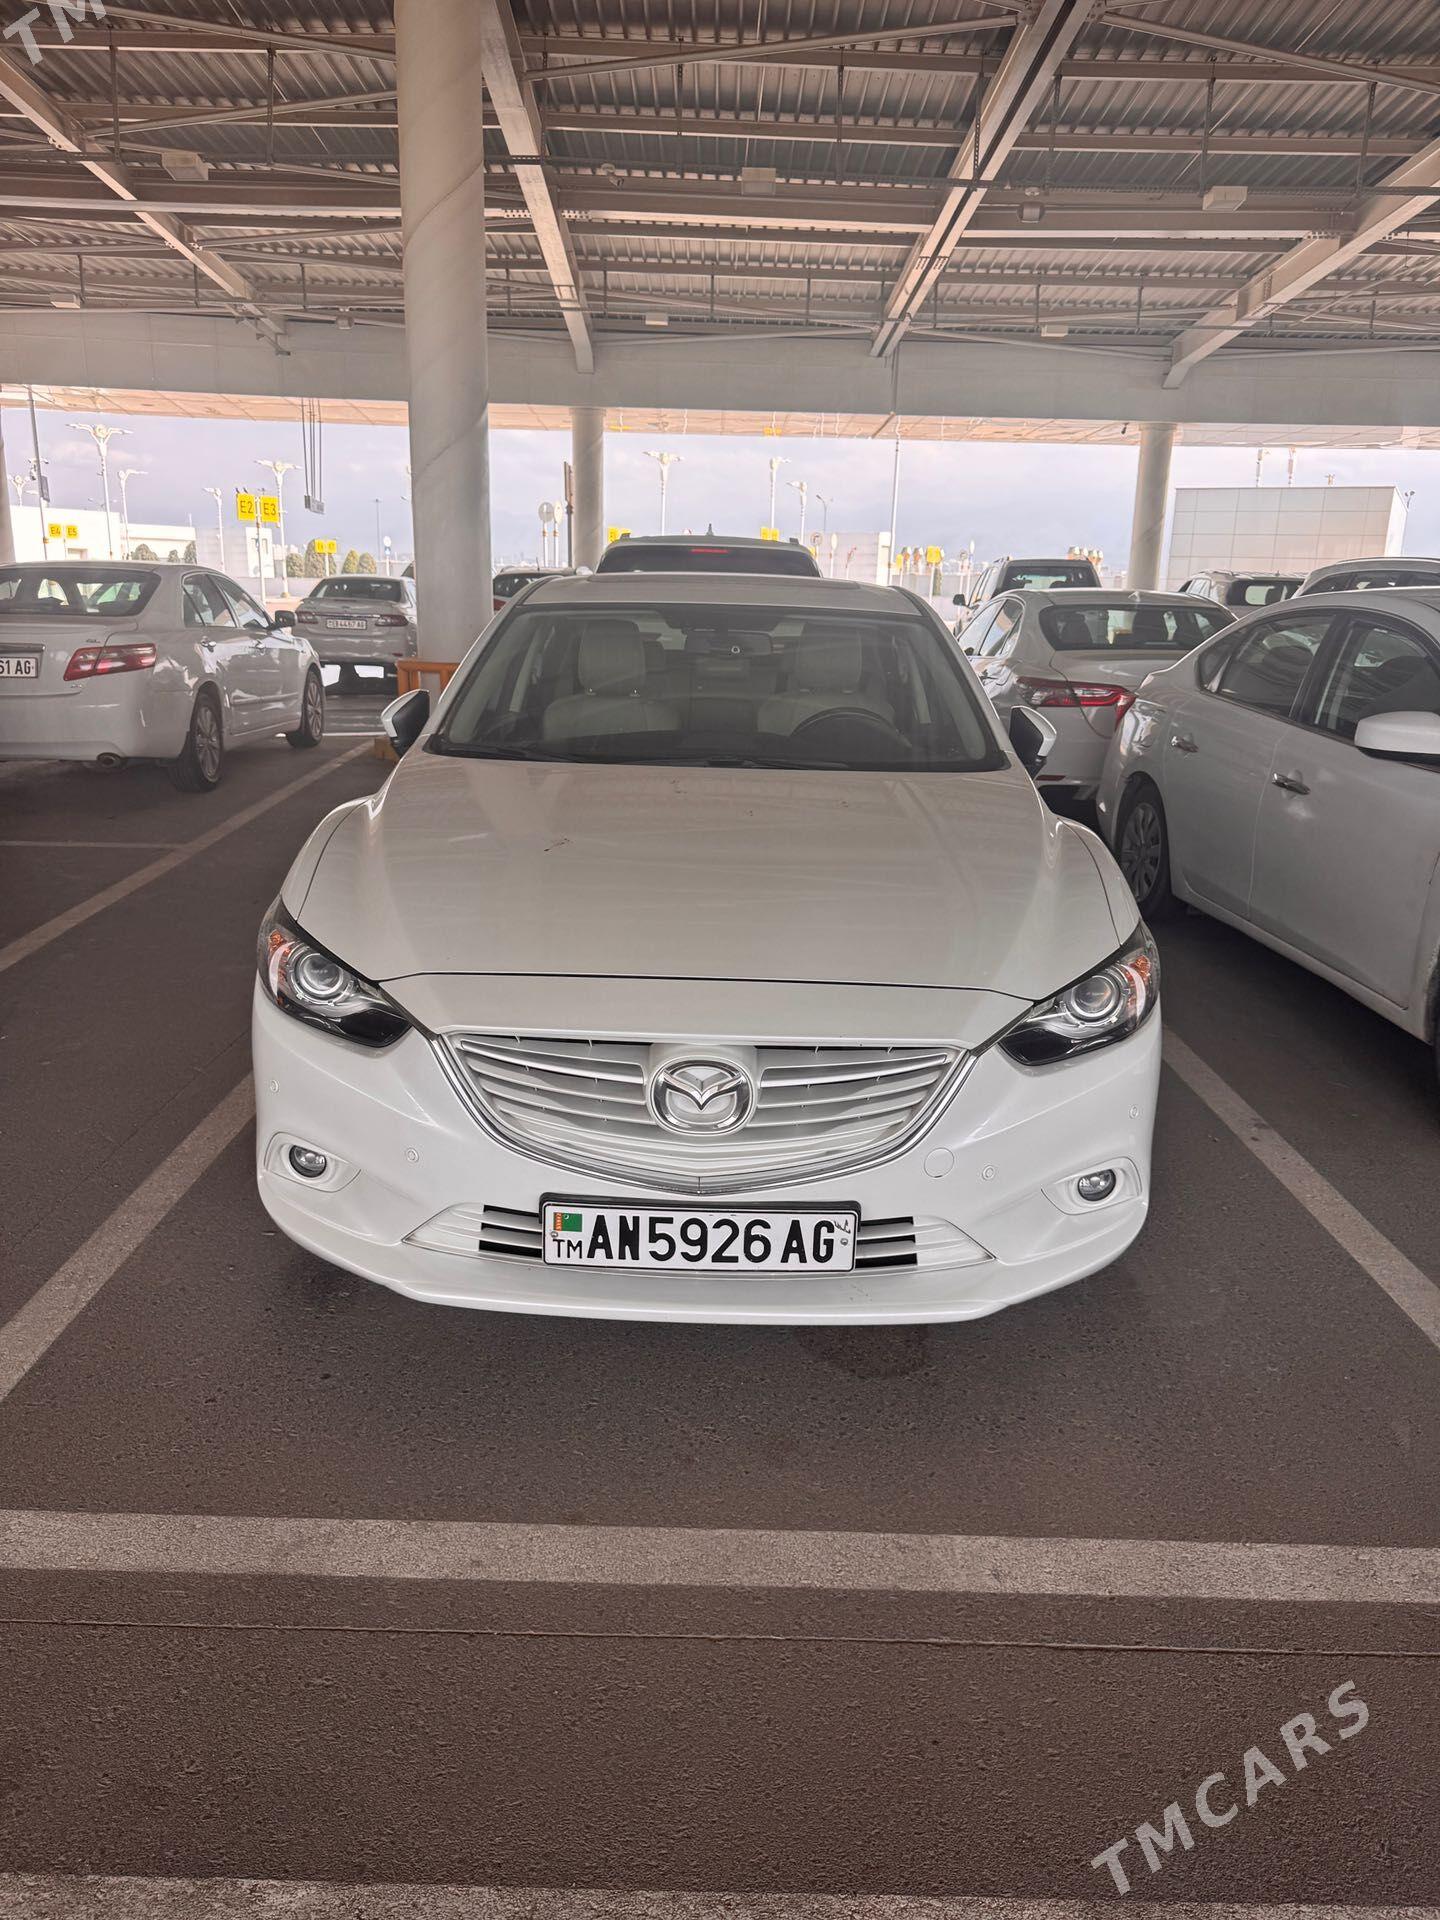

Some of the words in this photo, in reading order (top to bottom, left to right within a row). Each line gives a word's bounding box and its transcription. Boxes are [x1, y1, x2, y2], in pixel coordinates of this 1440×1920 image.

[240, 500, 254, 514] E2
[264, 502, 276, 516] E3
[50, 526, 61, 535] E4
[14, 660, 31, 675] AG
[552, 1239, 583, 1260] TM
